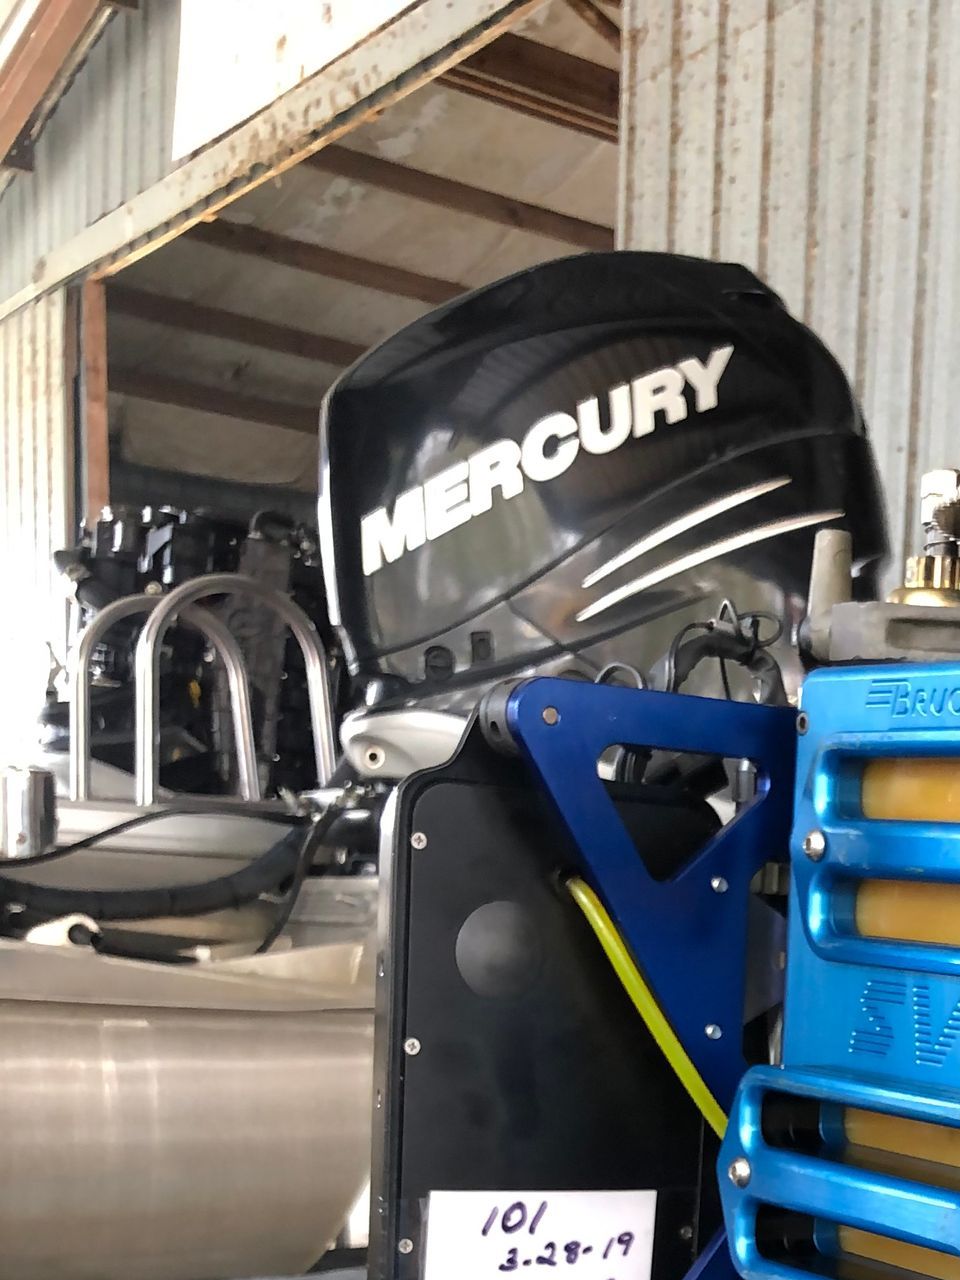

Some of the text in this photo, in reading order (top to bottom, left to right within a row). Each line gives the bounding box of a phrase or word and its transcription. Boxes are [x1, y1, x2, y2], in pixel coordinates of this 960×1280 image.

[360, 343, 734, 576] MERCURY
[481, 1200, 548, 1237] 101
[498, 1231, 635, 1272] 3-28-19
